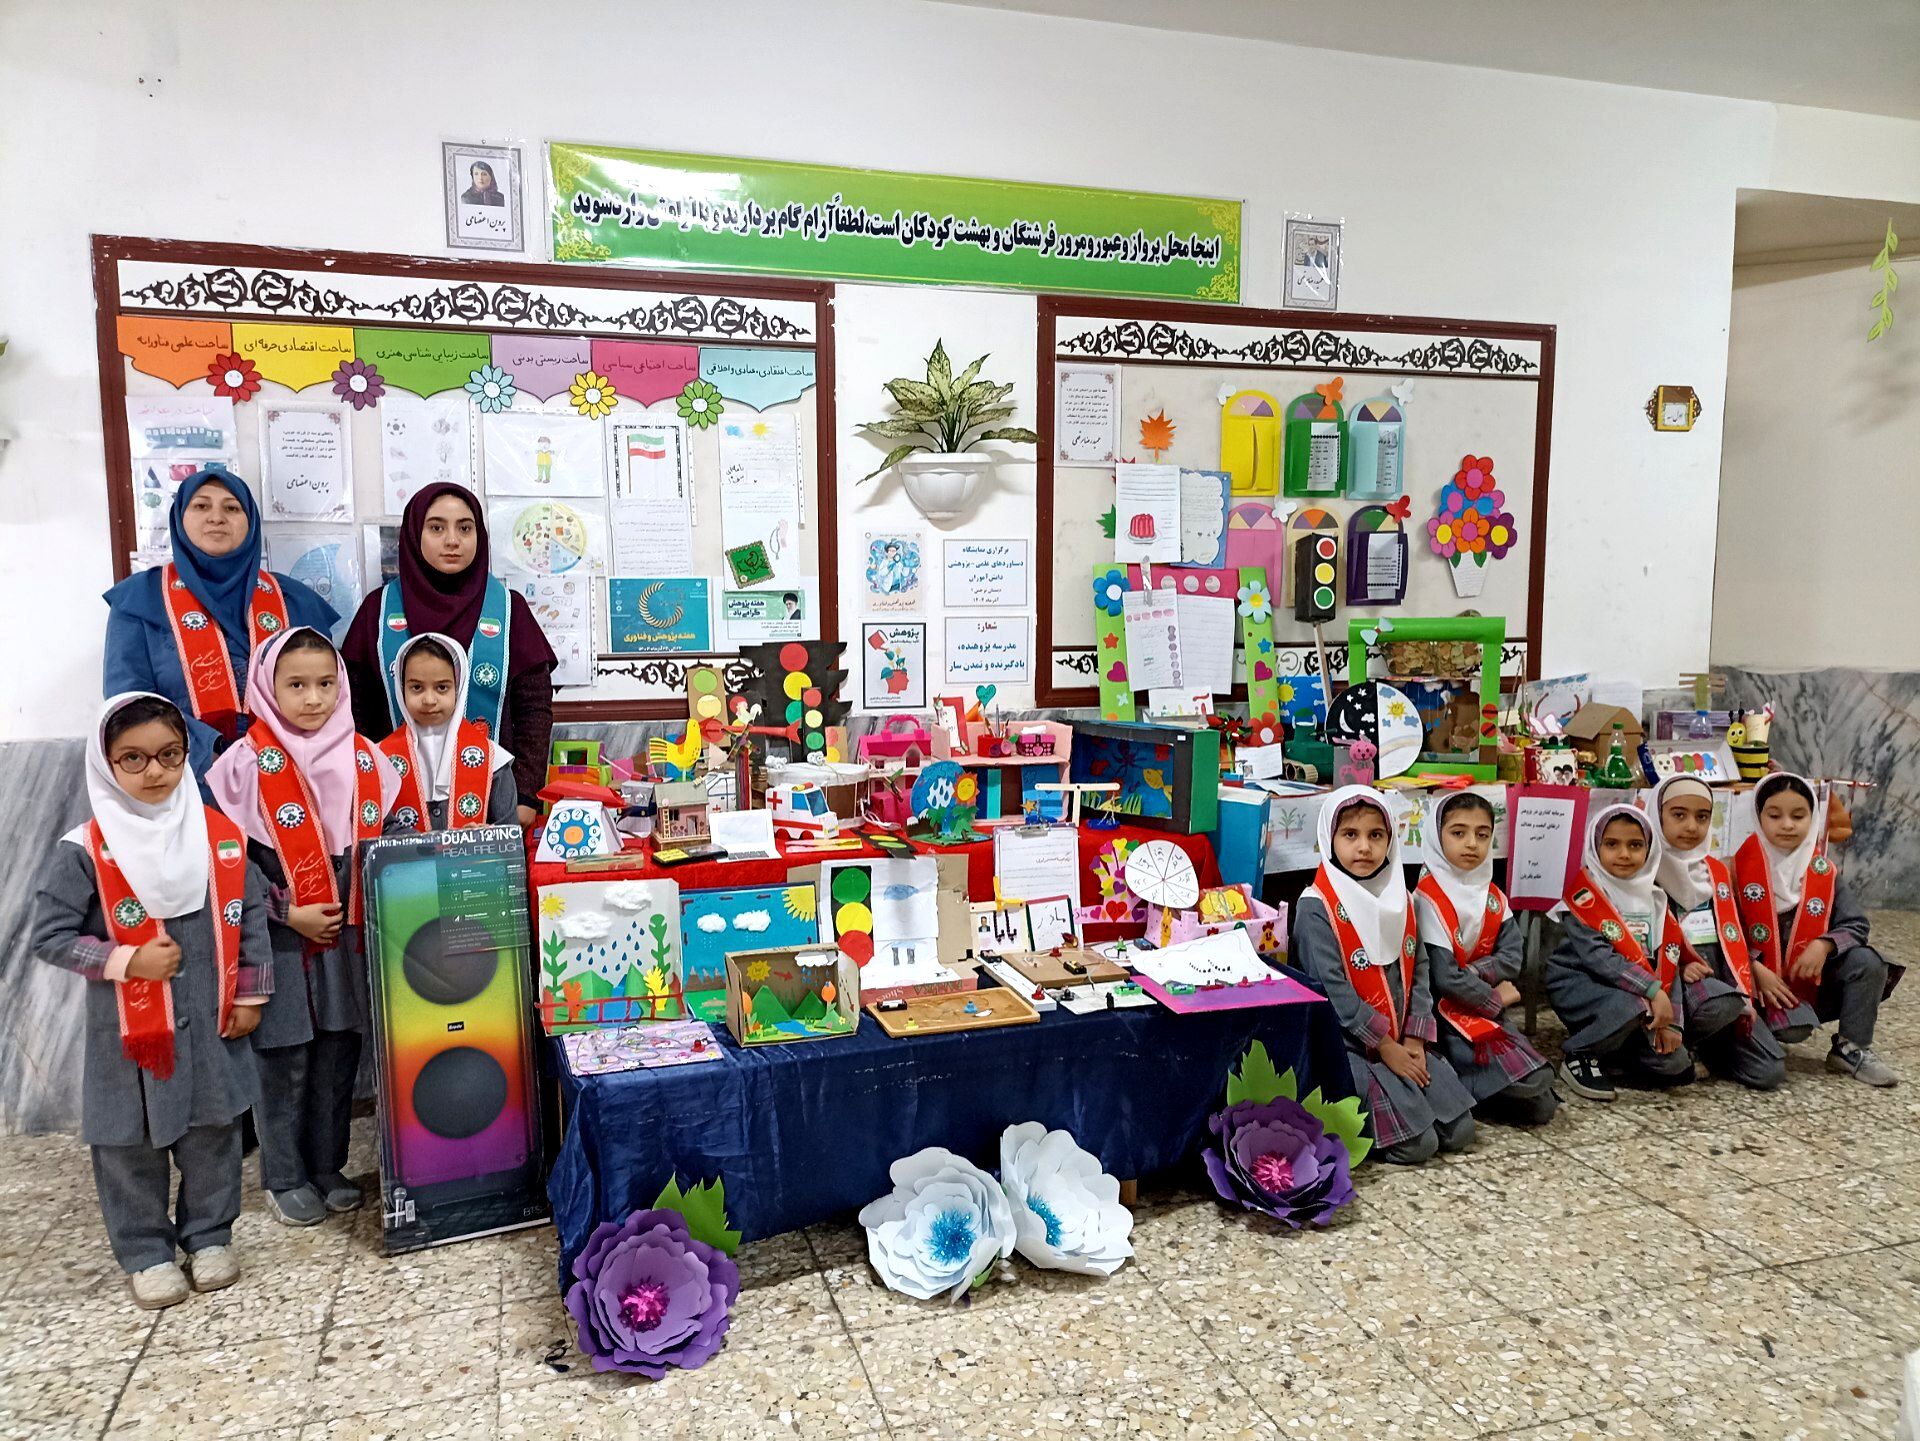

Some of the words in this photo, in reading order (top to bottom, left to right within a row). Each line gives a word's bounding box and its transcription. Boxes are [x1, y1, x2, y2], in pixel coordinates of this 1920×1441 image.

[778, 204, 802, 236] گام
[804, 204, 836, 239] آرام
[902, 214, 952, 248] کودکان
[954, 219, 991, 249] بهشت
[1002, 222, 1055, 255] فرشتگان
[992, 230, 1000, 251] و
[1057, 235, 1086, 257] مرور
[1094, 235, 1121, 259] عبور
[1130, 231, 1160, 263] پرواز
[1161, 233, 1189, 262] محل
[1191, 235, 1220, 264] اینجا
[170, 336, 193, 353] علمی
[195, 335, 229, 349] ساحت
[278, 337, 318, 353] اقتصادی
[319, 339, 352, 353] ساحت
[376, 349, 403, 359] هنری
[403, 347, 432, 361] شناسی
[459, 347, 489, 360] ساحت
[561, 352, 589, 365] ساحت
[602, 355, 633, 372] سیاسی
[633, 357, 665, 374] اجتماعی
[667, 356, 696, 371] ساحت
[962, 546, 986, 554] نمایشگاه
[986, 546, 1009, 555] برگزاری
[652, 631, 678, 643] پژوهش
[677, 632, 696, 640] هفته
[889, 628, 920, 639] پژوهش
[992, 643, 1017, 652] مدرسه
[441, 830, 477, 846] DUAL
[442, 847, 472, 858] REAL
